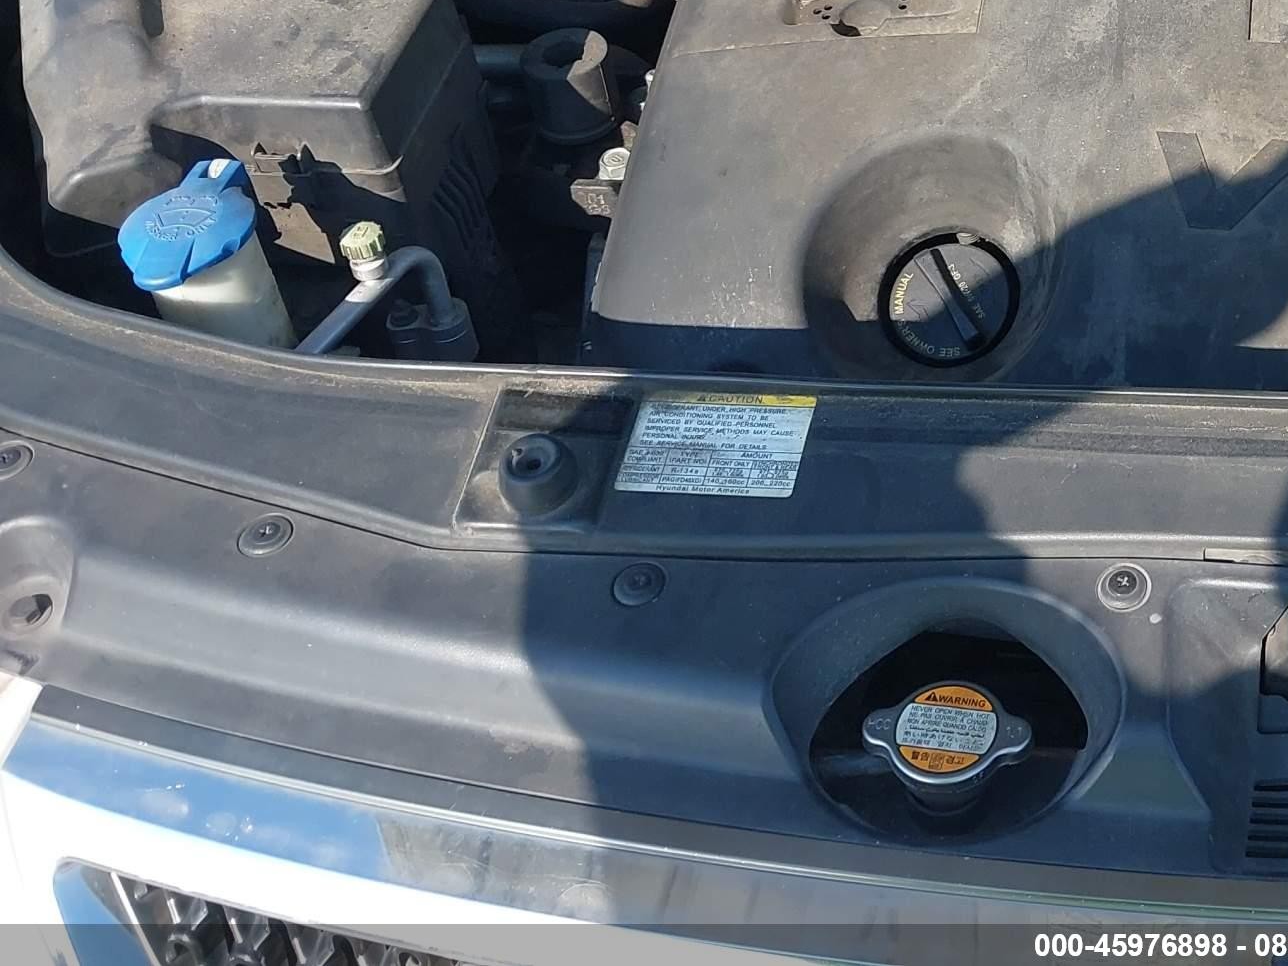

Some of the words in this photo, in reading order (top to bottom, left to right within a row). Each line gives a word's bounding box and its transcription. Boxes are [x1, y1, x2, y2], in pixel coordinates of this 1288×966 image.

[894, 272, 914, 315] MANUAL
[939, 346, 961, 357] SEE
[709, 395, 763, 404] CAUTION
[938, 695, 986, 708] WARNING
[911, 705, 932, 713] NEVER
